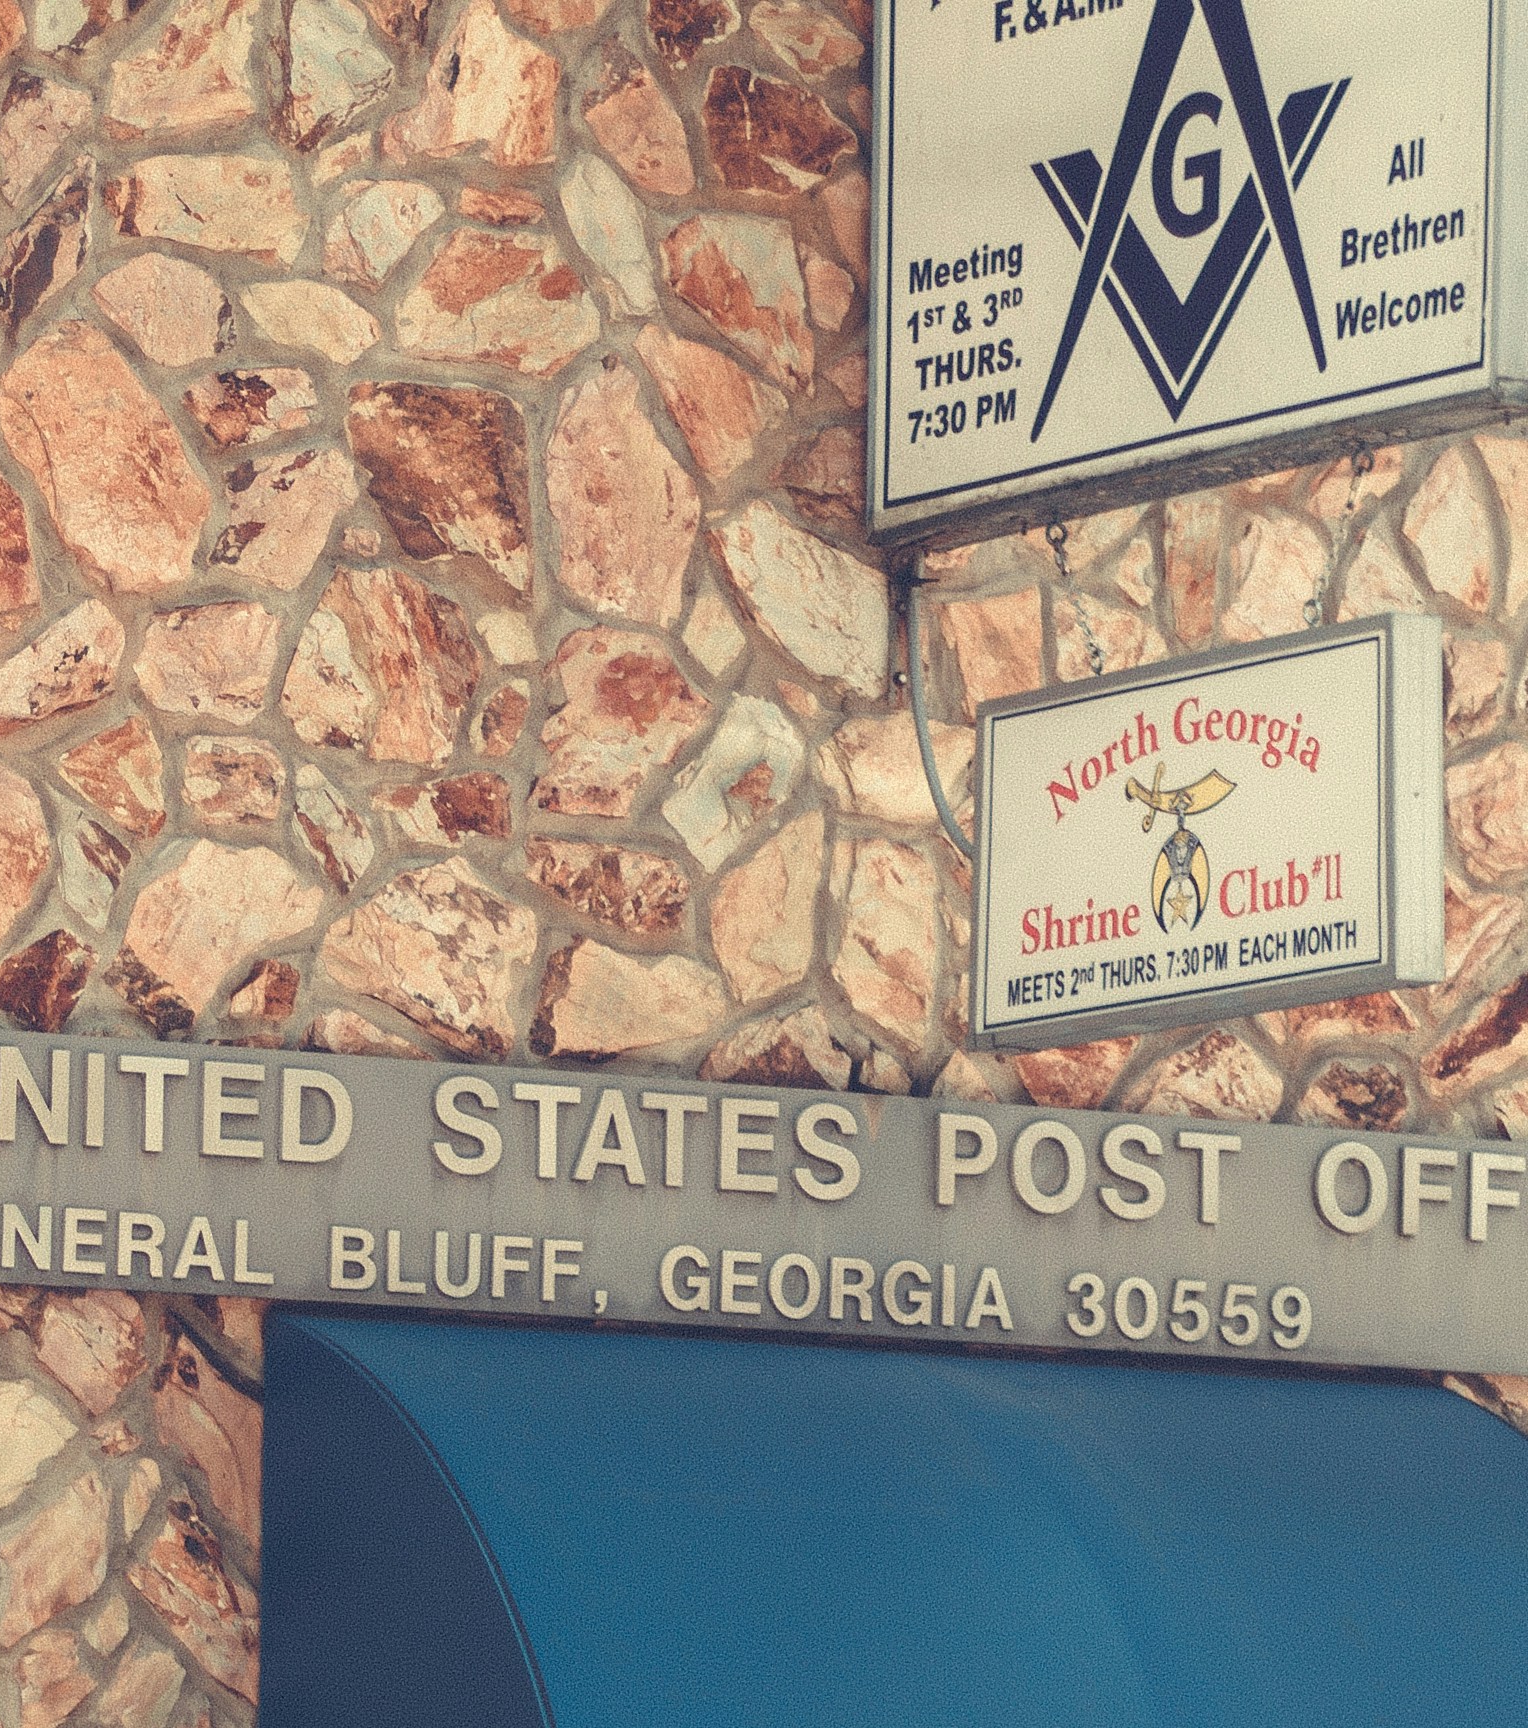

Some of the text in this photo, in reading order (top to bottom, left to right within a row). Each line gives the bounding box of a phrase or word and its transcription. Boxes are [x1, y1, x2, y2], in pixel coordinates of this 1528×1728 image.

[1152, 91, 1223, 239] G
[1387, 136, 1425, 186] All
[908, 243, 1023, 295] Meeting
[1340, 207, 1465, 269] Brethren
[906, 286, 1023, 344] 1ST & 3RD
[1335, 281, 1466, 340] Welcome
[914, 337, 1022, 391] THURS.
[907, 388, 1017, 444] 7:30 PM
[1045, 695, 1321, 825] North Georgia
[1021, 898, 1141, 956] Shrine
[1218, 857, 1310, 920] Club
[1006, 918, 1358, 1007] MEETS 2nd THURS. 7:30 PM EACH MONTH
[430, 1072, 862, 1202] STATES
[932, 1110, 1243, 1227] POST
[326, 1222, 611, 1317] BLUFF,
[658, 1243, 1015, 1332] GEORGIA
[1065, 1270, 1314, 1350] 30559
